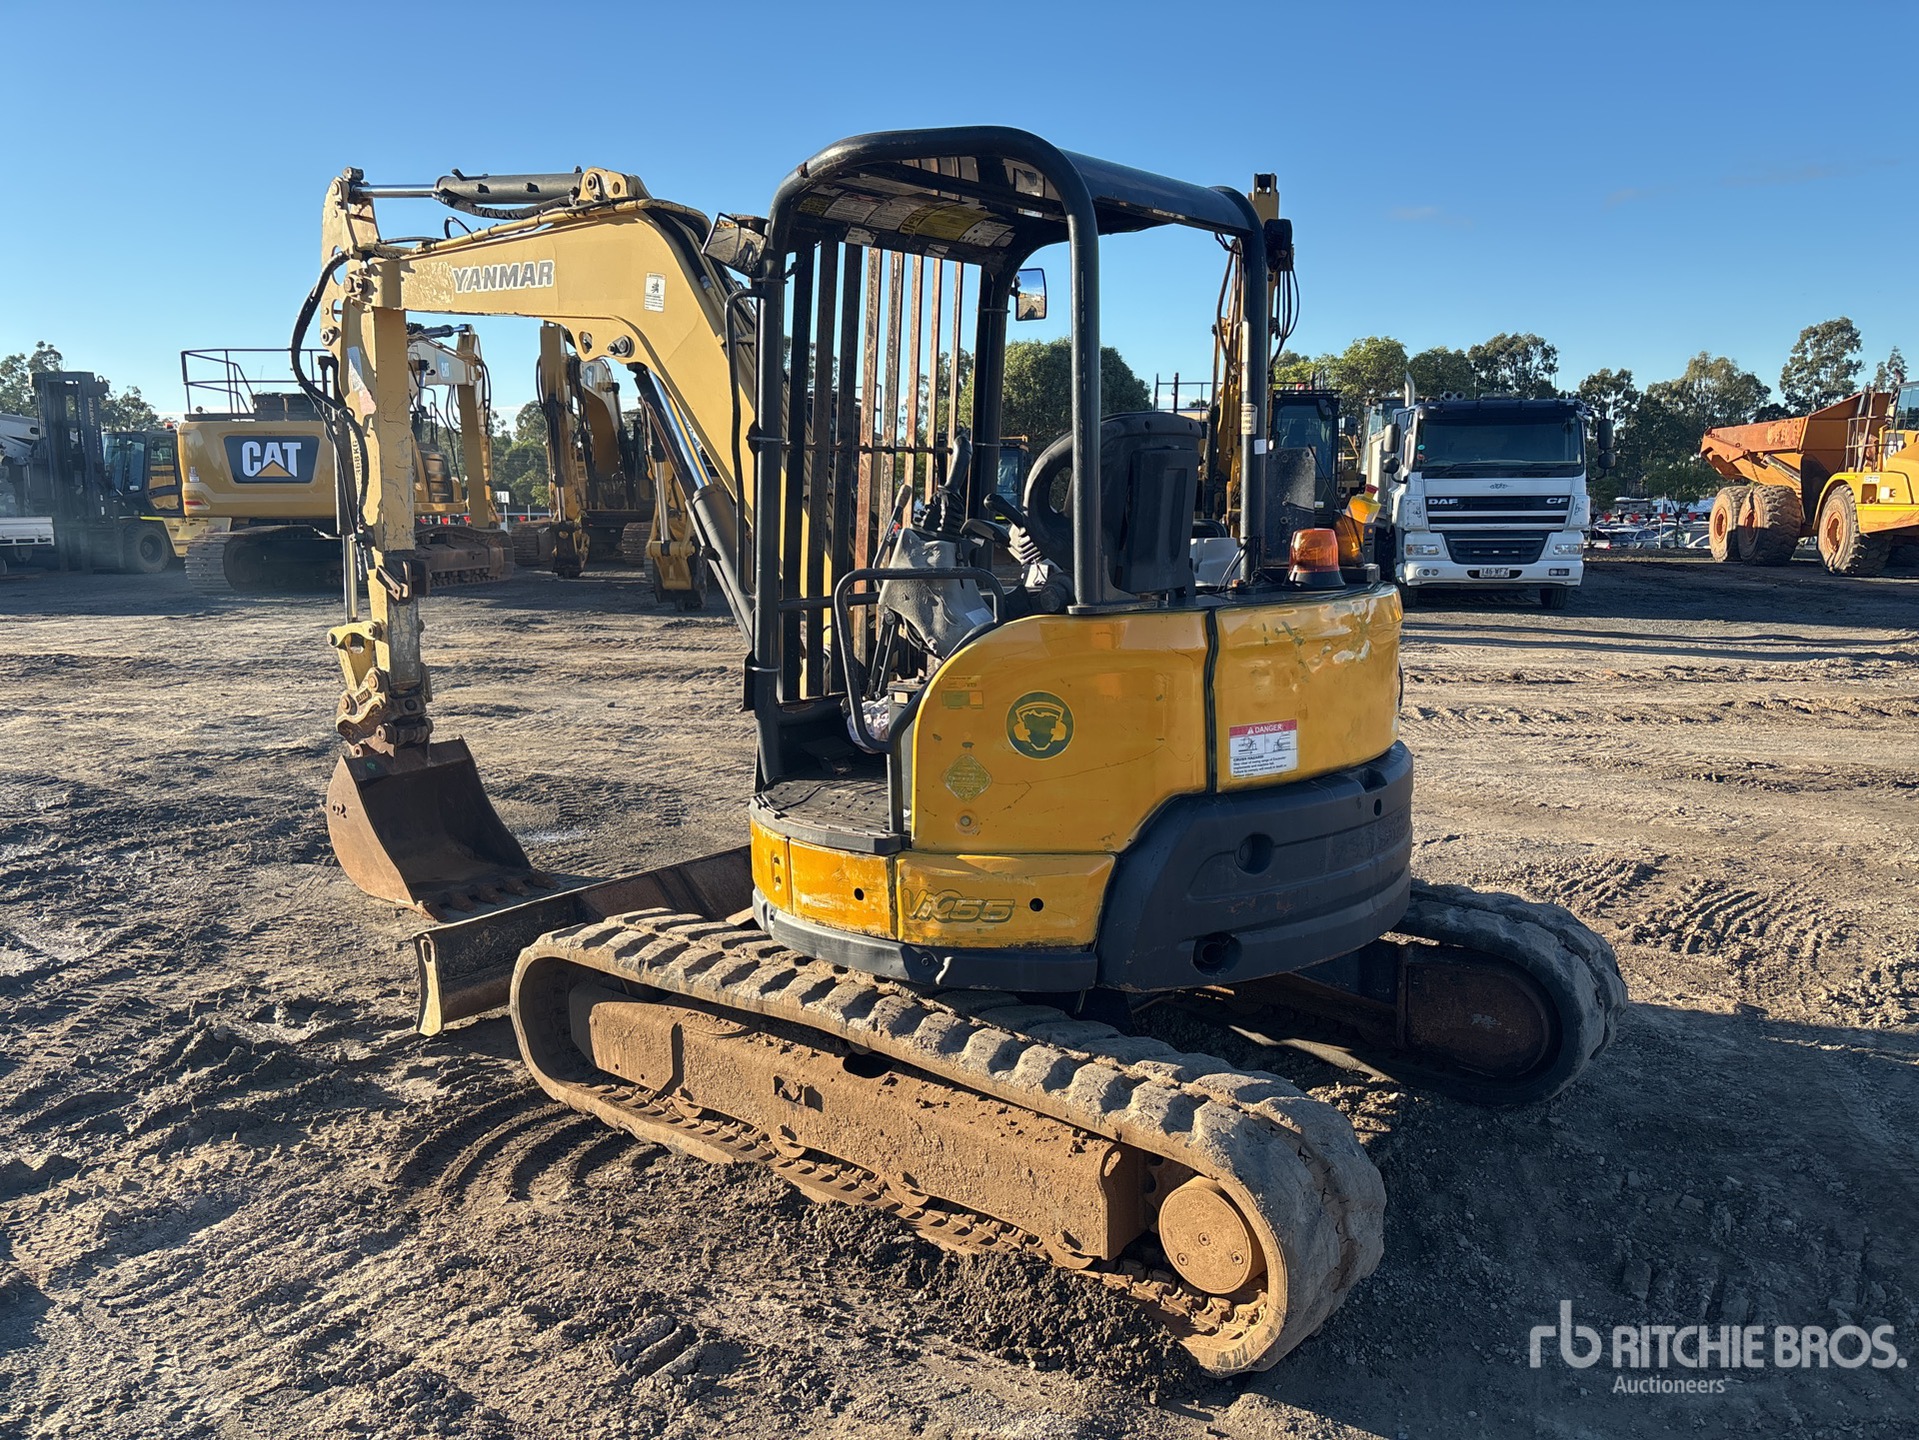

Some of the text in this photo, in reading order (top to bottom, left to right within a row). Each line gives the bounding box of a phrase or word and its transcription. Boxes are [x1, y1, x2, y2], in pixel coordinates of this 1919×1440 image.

[453, 259, 555, 293] YANMAR
[241, 441, 302, 478] CAT
[1546, 497, 1569, 505] CF
[1254, 724, 1283, 734] DANGER
